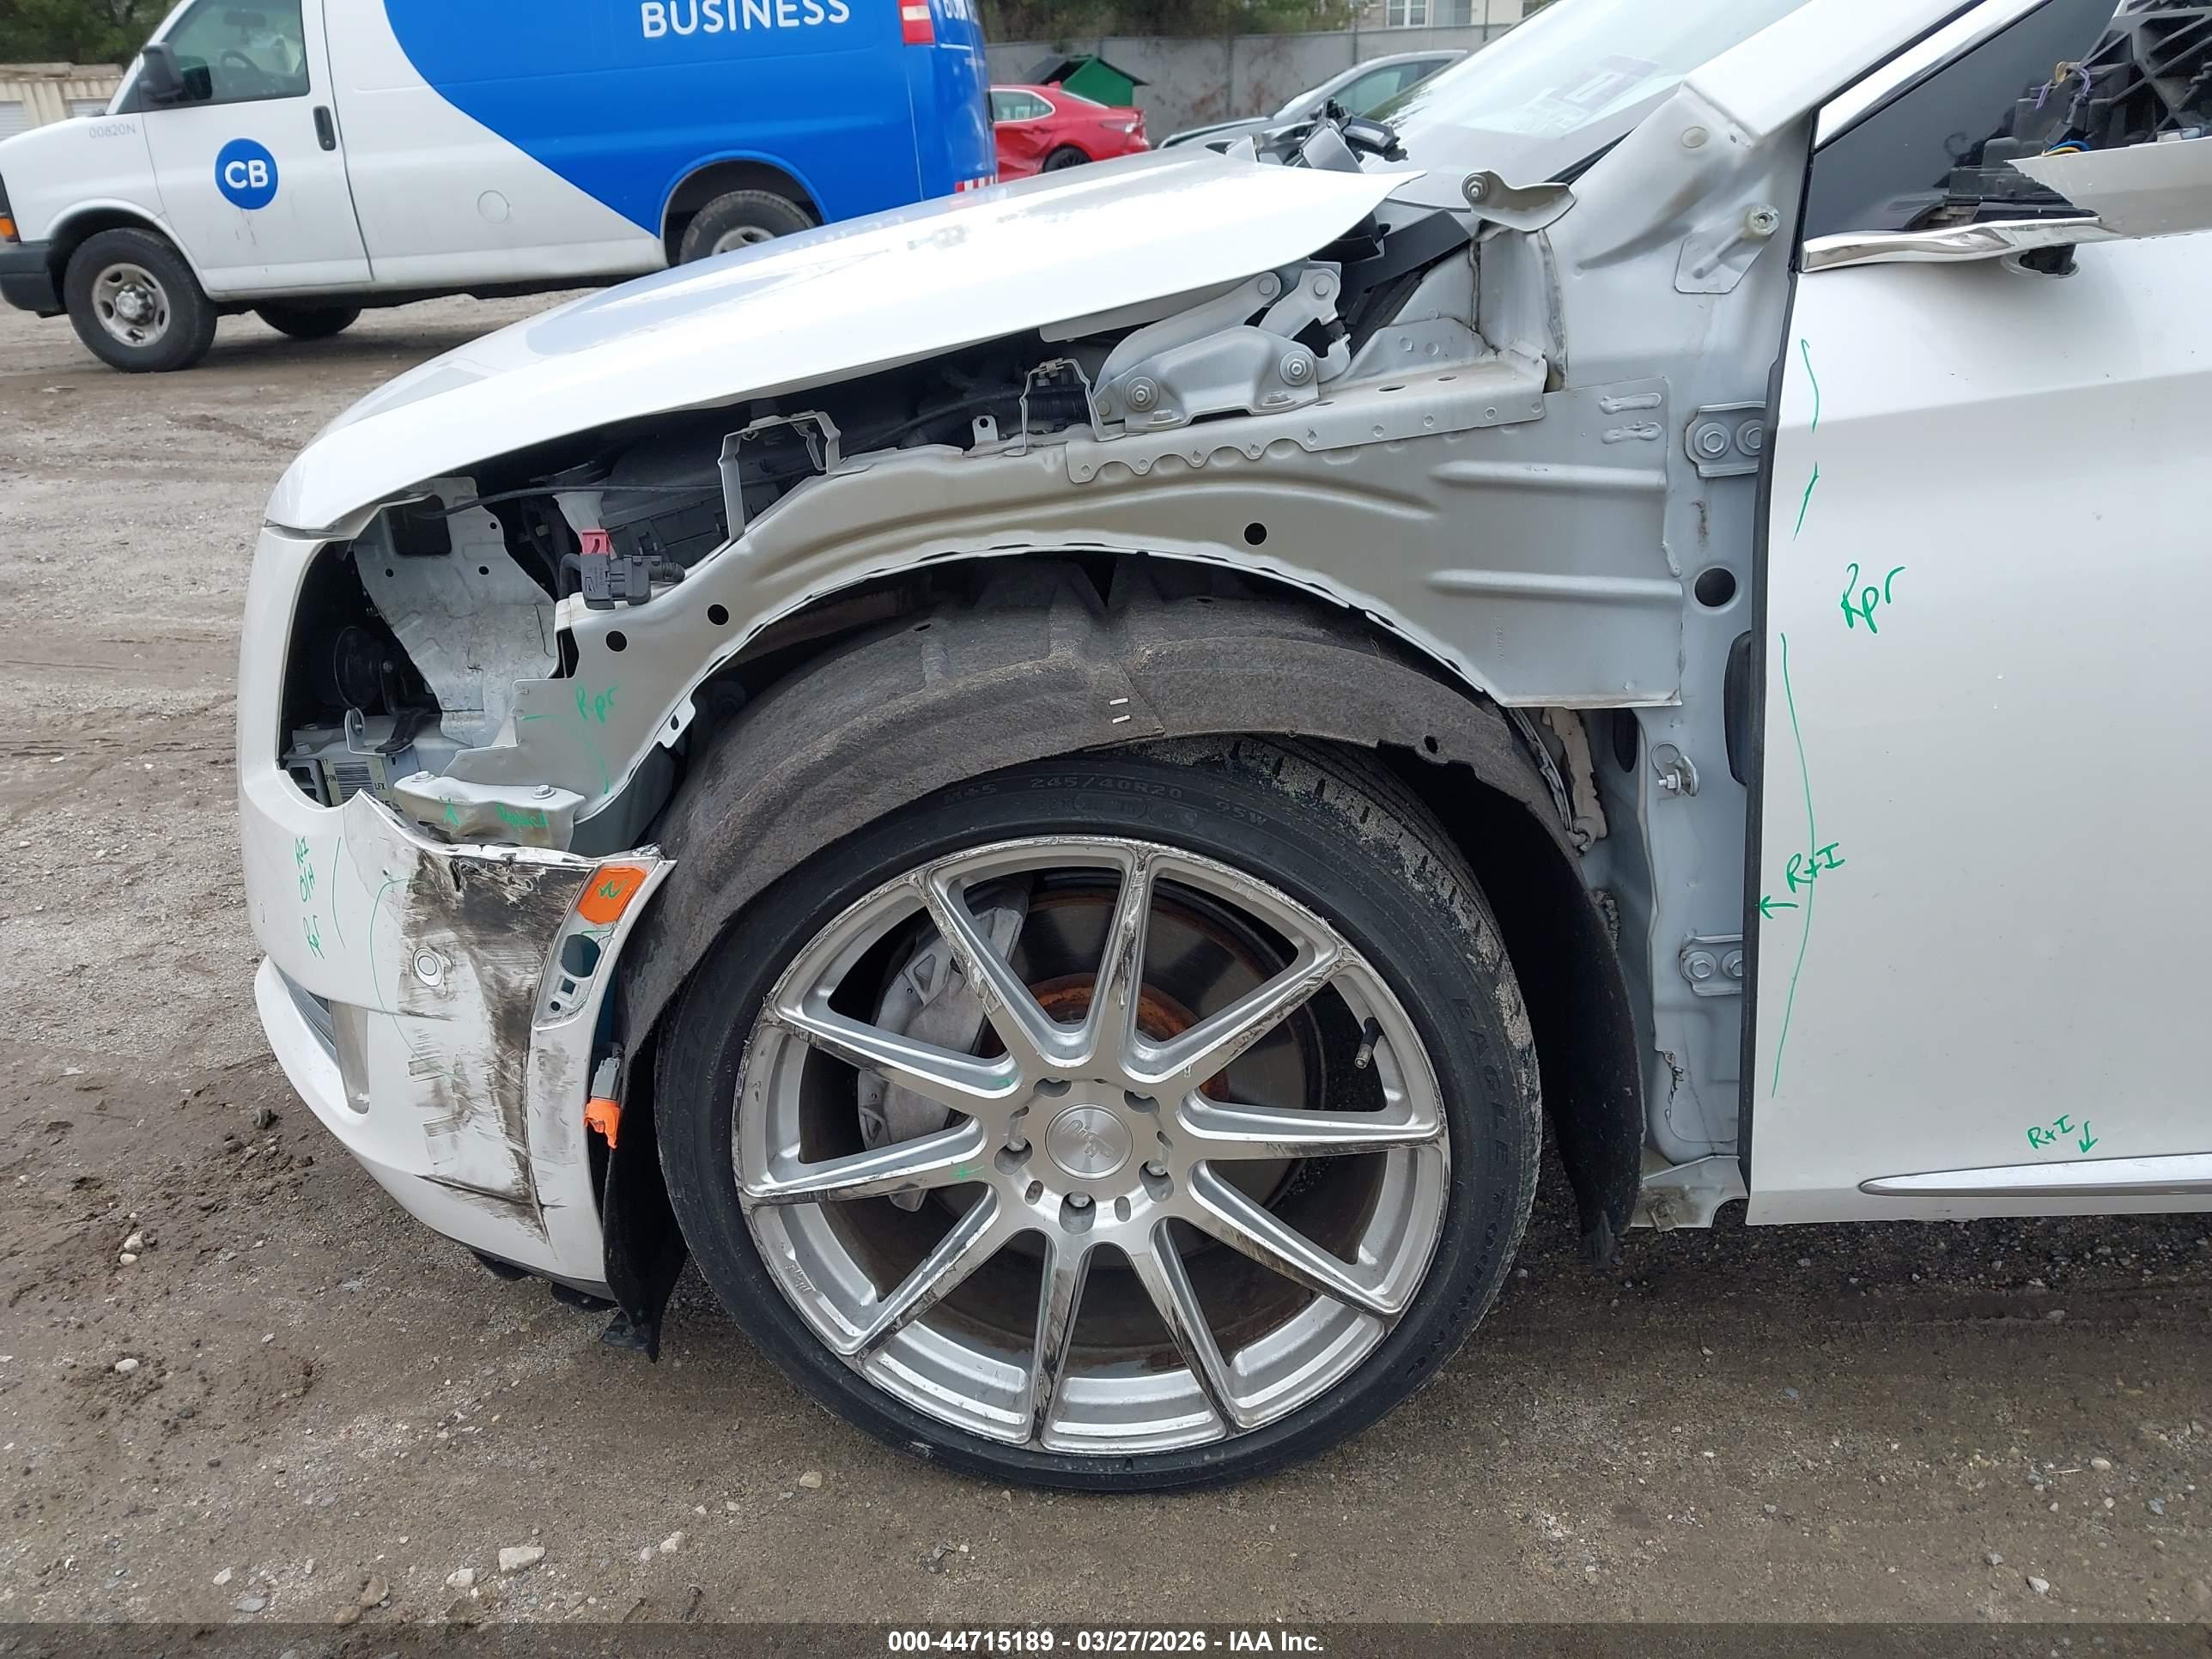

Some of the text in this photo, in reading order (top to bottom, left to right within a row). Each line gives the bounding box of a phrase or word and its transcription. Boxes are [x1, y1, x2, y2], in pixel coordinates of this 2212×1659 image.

[641, 0, 850, 38] BUSINESS
[224, 159, 269, 189] CB
[1840, 562, 1906, 634] Rpr
[1030, 775, 1183, 799] 245/40R20
